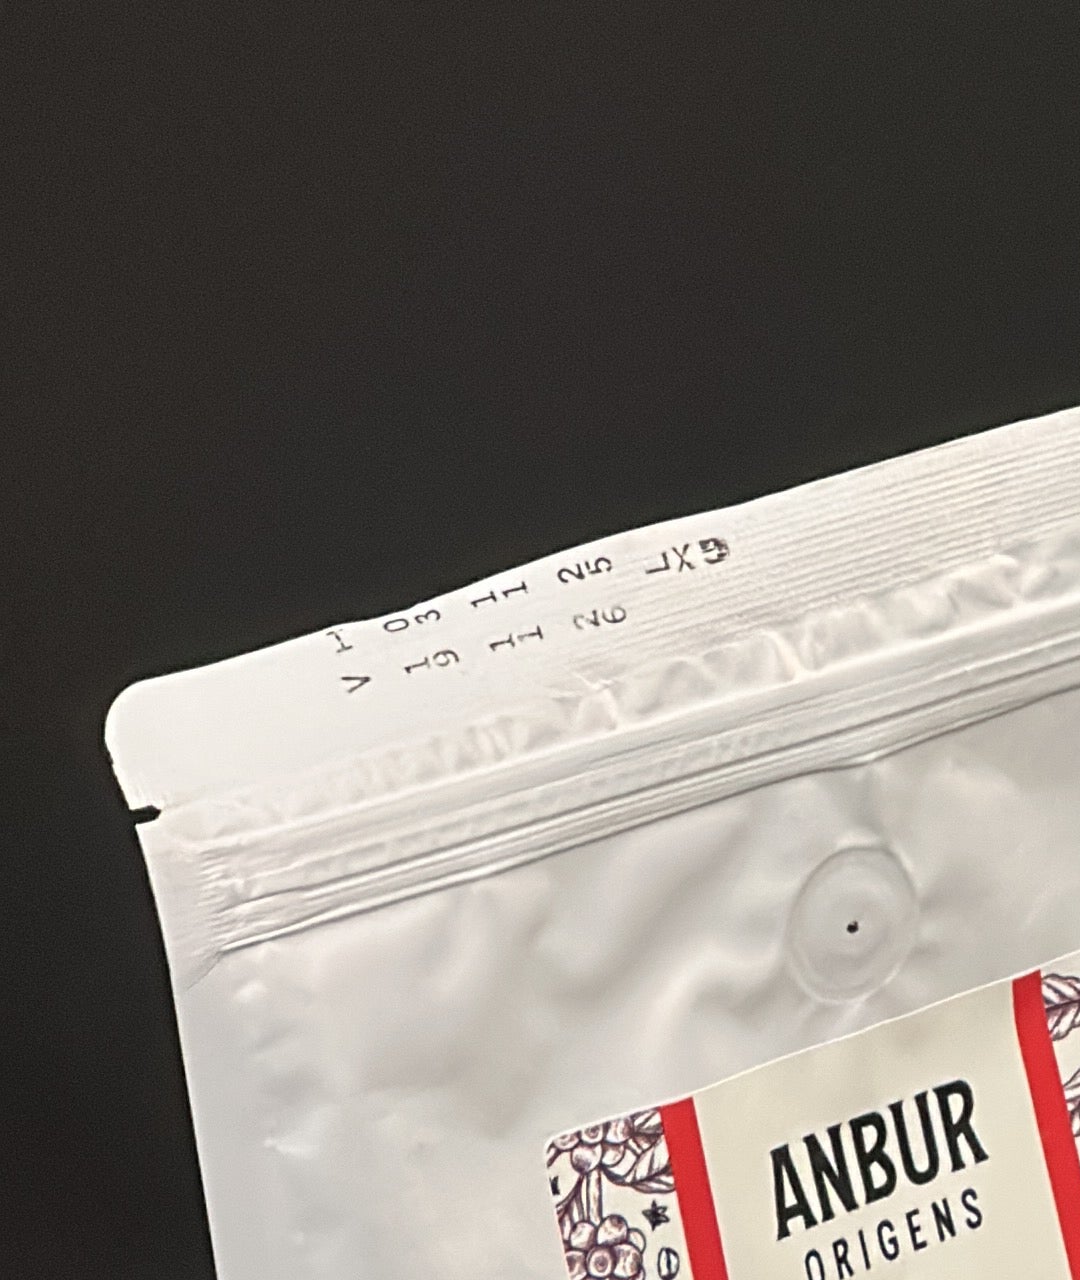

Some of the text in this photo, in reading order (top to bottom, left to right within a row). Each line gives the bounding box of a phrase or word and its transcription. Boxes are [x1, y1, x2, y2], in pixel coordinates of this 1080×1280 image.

[557, 556, 613, 584] 25
[341, 675, 371, 693] V
[769, 1079, 989, 1241] ANBUR
